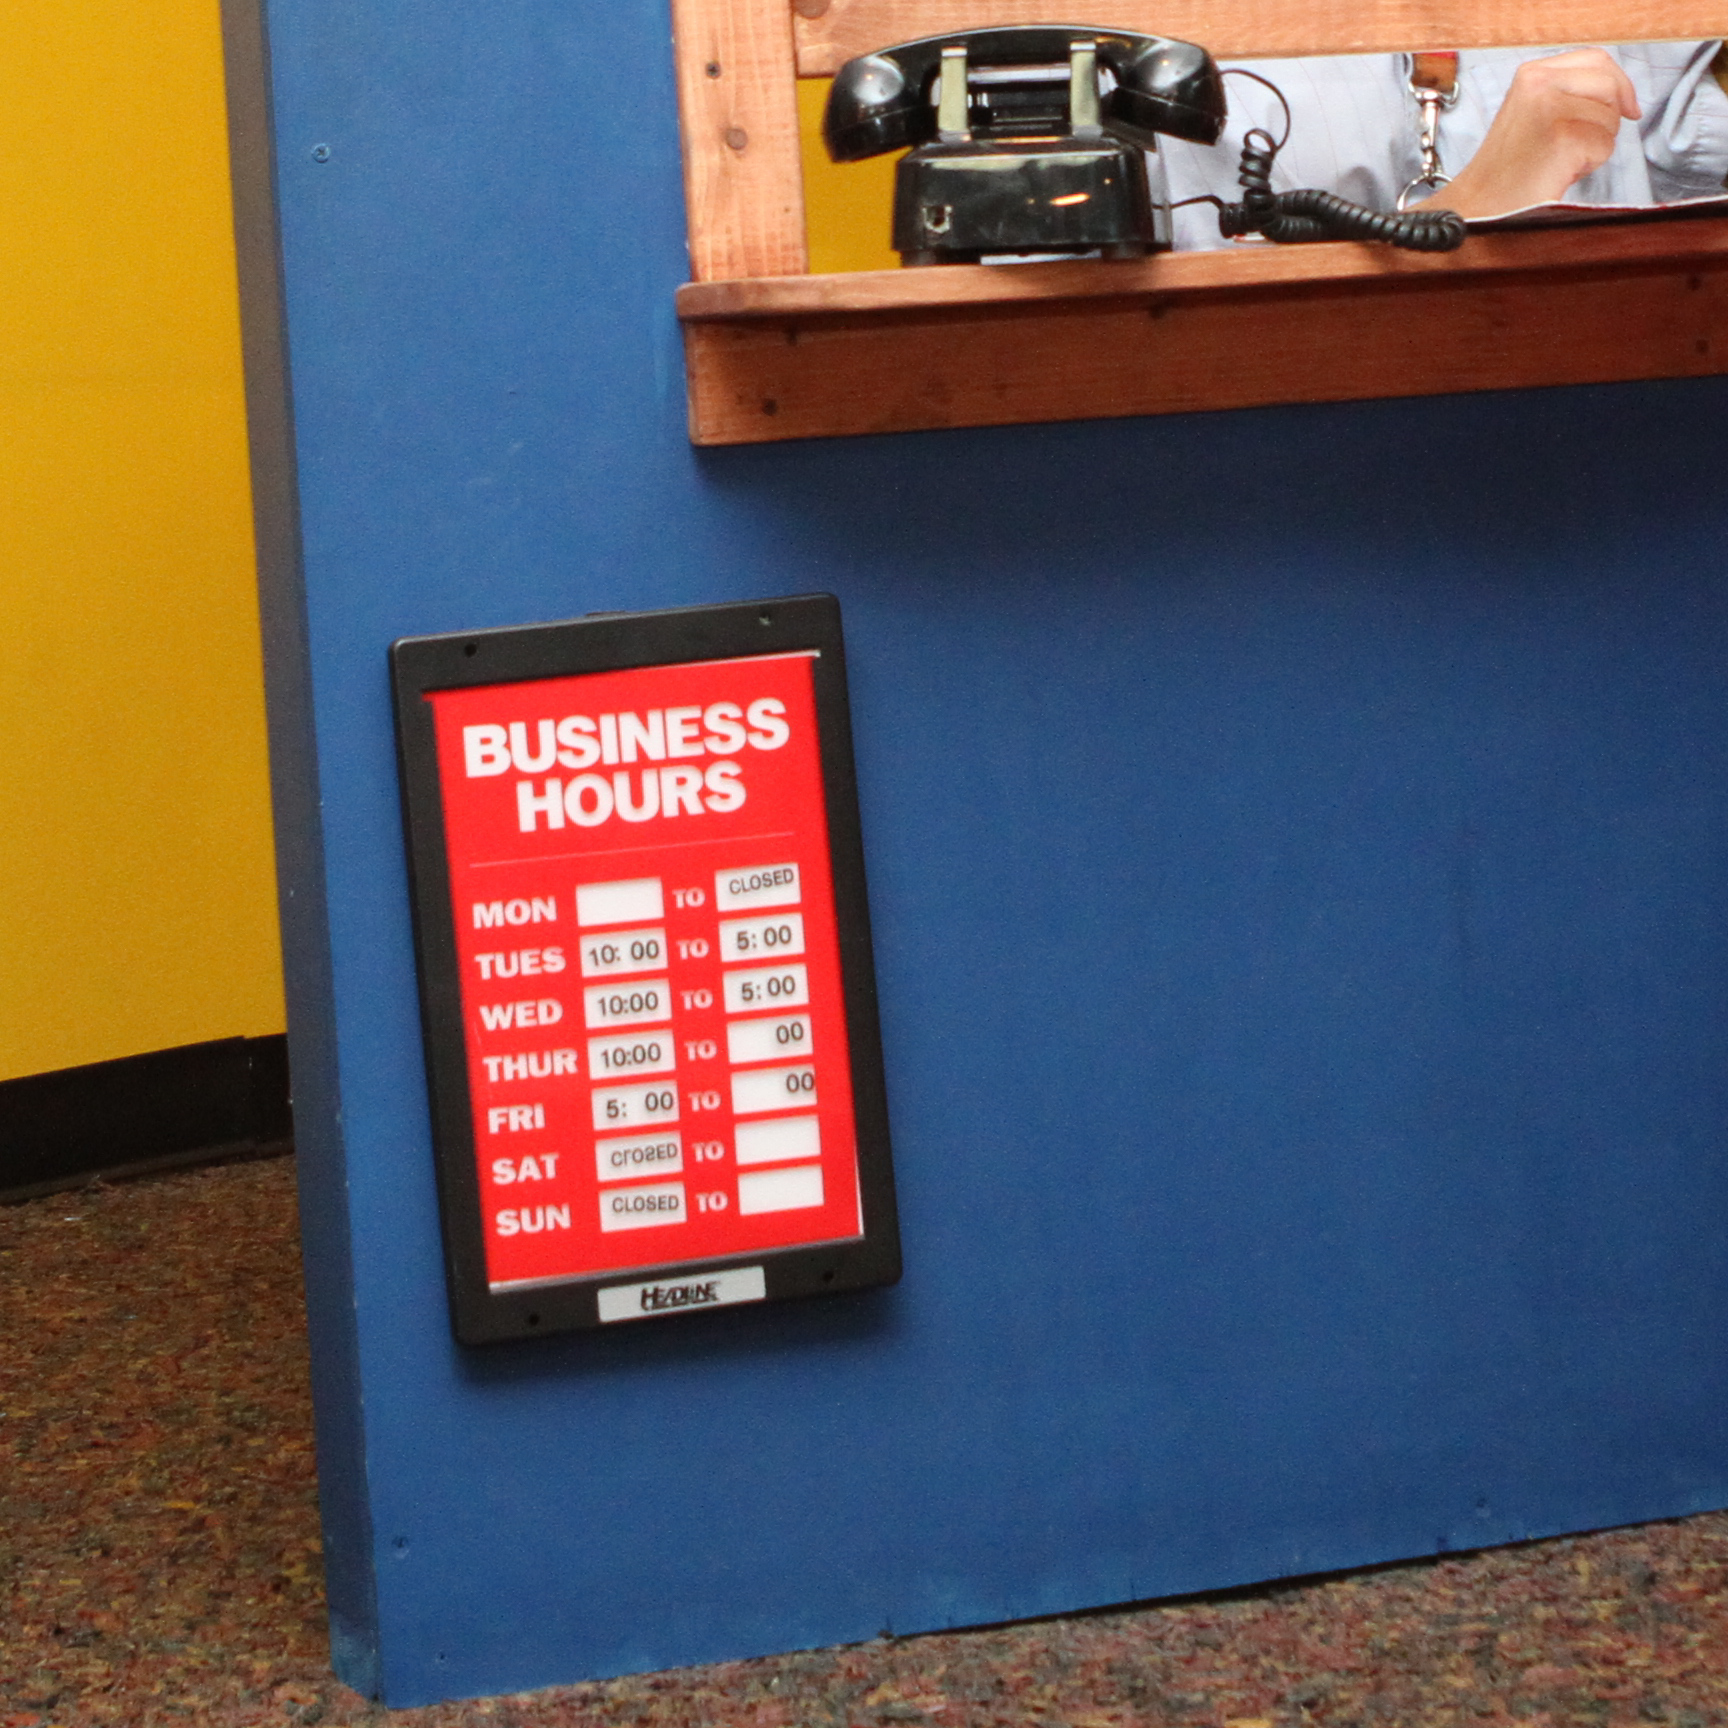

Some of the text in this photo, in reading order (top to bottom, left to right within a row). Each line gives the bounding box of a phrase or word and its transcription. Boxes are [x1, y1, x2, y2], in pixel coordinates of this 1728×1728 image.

[462, 697, 791, 778] BUSINESS
[516, 761, 748, 833] HOURS
[472, 868, 794, 929] MON TO CLOSED
[475, 947, 566, 980] TUES
[676, 938, 710, 961] TO
[479, 998, 564, 1032] WED
[597, 991, 659, 1017] 10:00
[681, 988, 714, 1011] TO
[483, 1021, 805, 1083] THUR 10:00 TO 00
[487, 1103, 546, 1134] FRI
[688, 1090, 722, 1113] TO
[785, 1071, 815, 1094] 00
[491, 1153, 560, 1186] SAT
[692, 1140, 725, 1164] TO
[495, 1190, 729, 1238] SUN CLOSED TO
